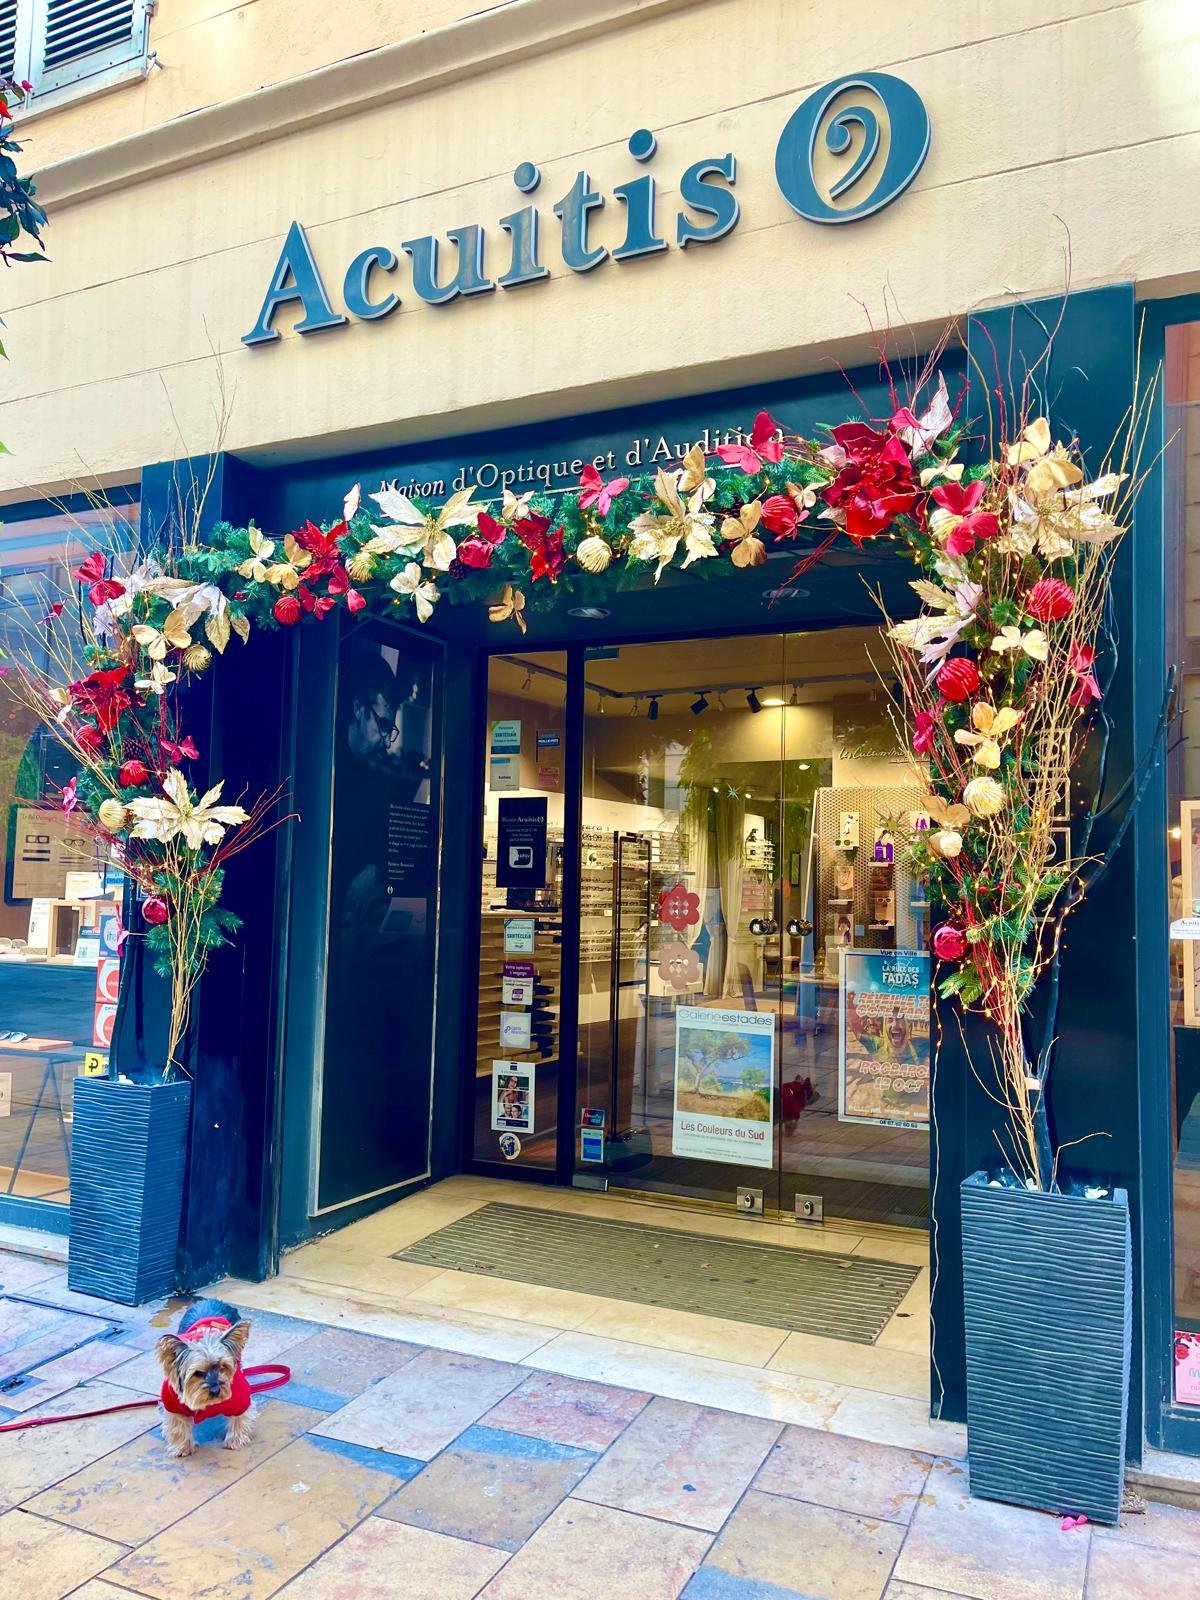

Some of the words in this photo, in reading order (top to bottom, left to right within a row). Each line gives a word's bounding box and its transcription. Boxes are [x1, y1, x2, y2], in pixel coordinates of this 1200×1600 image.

[241, 129, 740, 347] Acuitis
[453, 459, 583, 494] d'Optique
[592, 450, 616, 470] et
[882, 973, 920, 985] FADAS
[681, 1121, 695, 1132] Les
[697, 1123, 733, 1137] Couleurs
[735, 1128, 746, 1138] du
[748, 1129, 765, 1141] Sud
